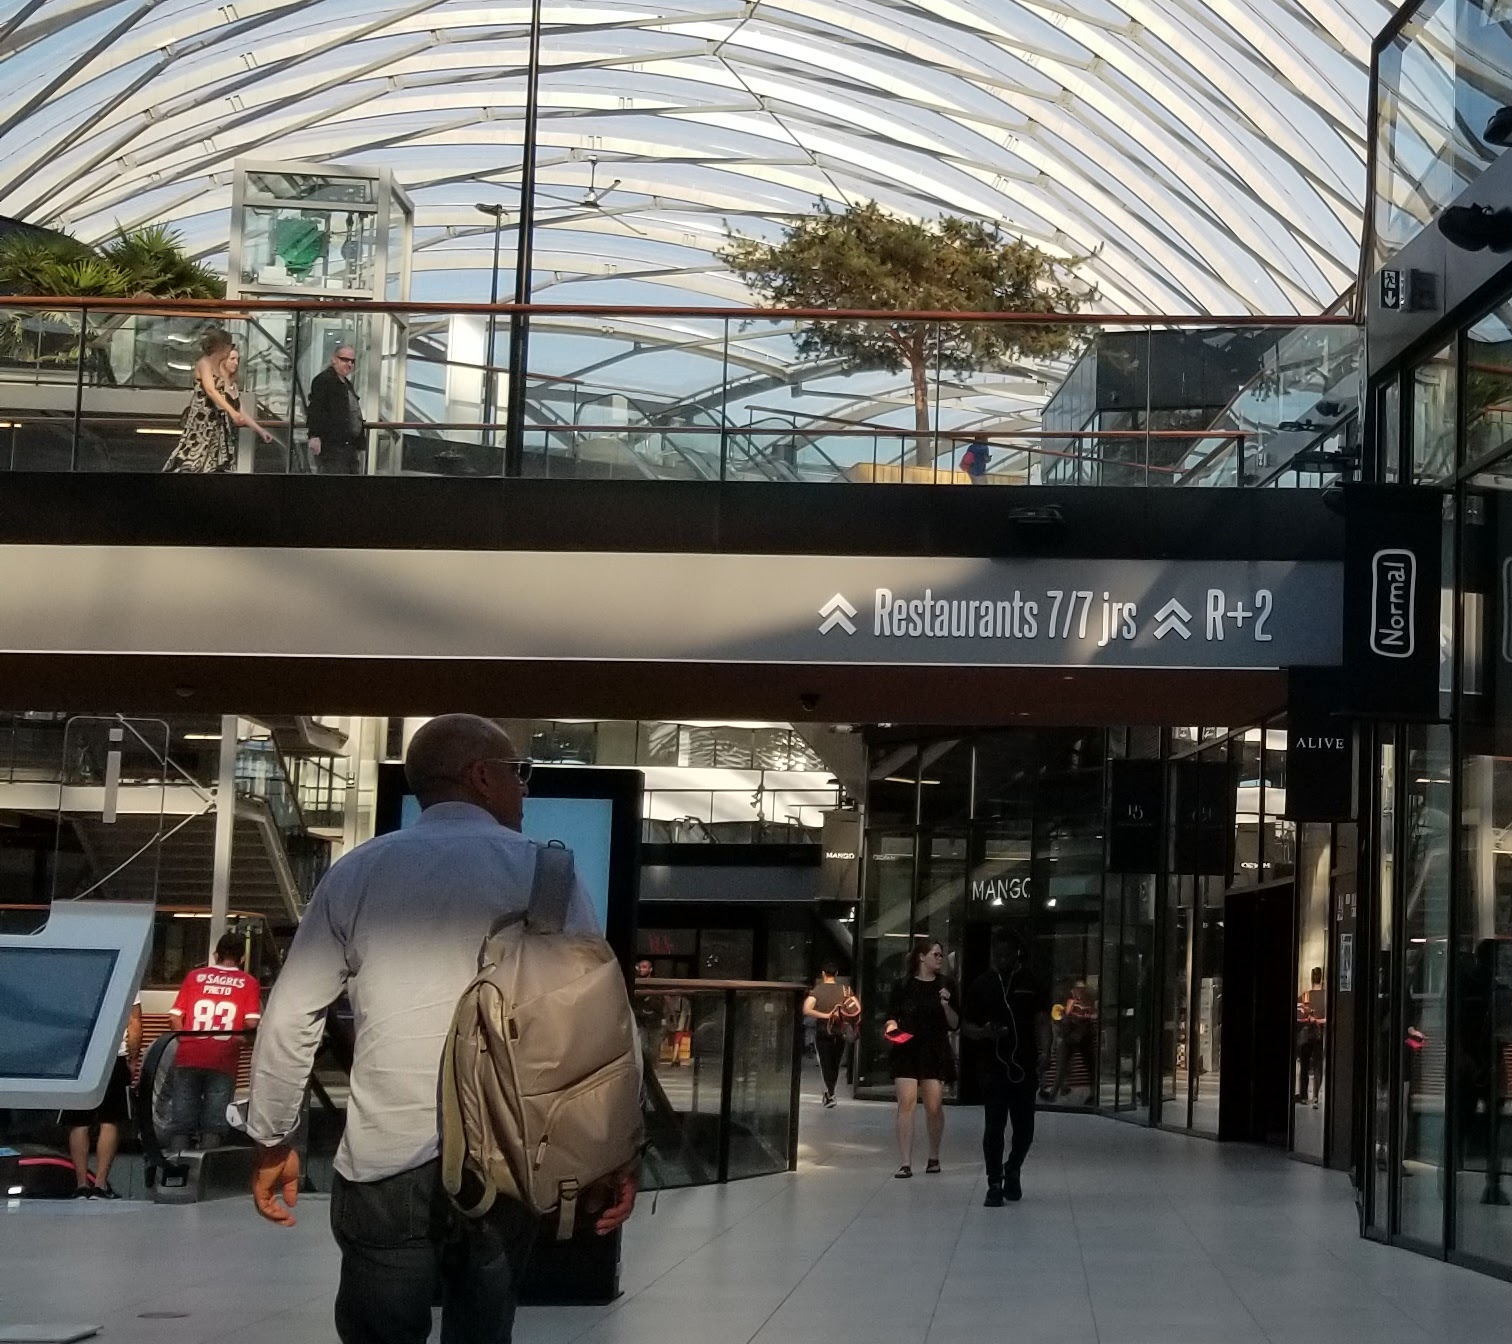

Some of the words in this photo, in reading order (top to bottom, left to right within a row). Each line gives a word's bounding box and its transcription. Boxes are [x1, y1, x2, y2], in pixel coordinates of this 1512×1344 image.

[873, 588, 1039, 639] Restaurants
[1047, 590, 1094, 639] 7/7
[1097, 592, 1138, 647] jrs
[1205, 588, 1274, 641] R+2
[1378, 561, 1406, 646] Normal
[1295, 736, 1345, 750] ALIVE
[825, 851, 855, 860] MANGO
[206, 973, 245, 988] SAGRES
[191, 999, 237, 1040] 83
